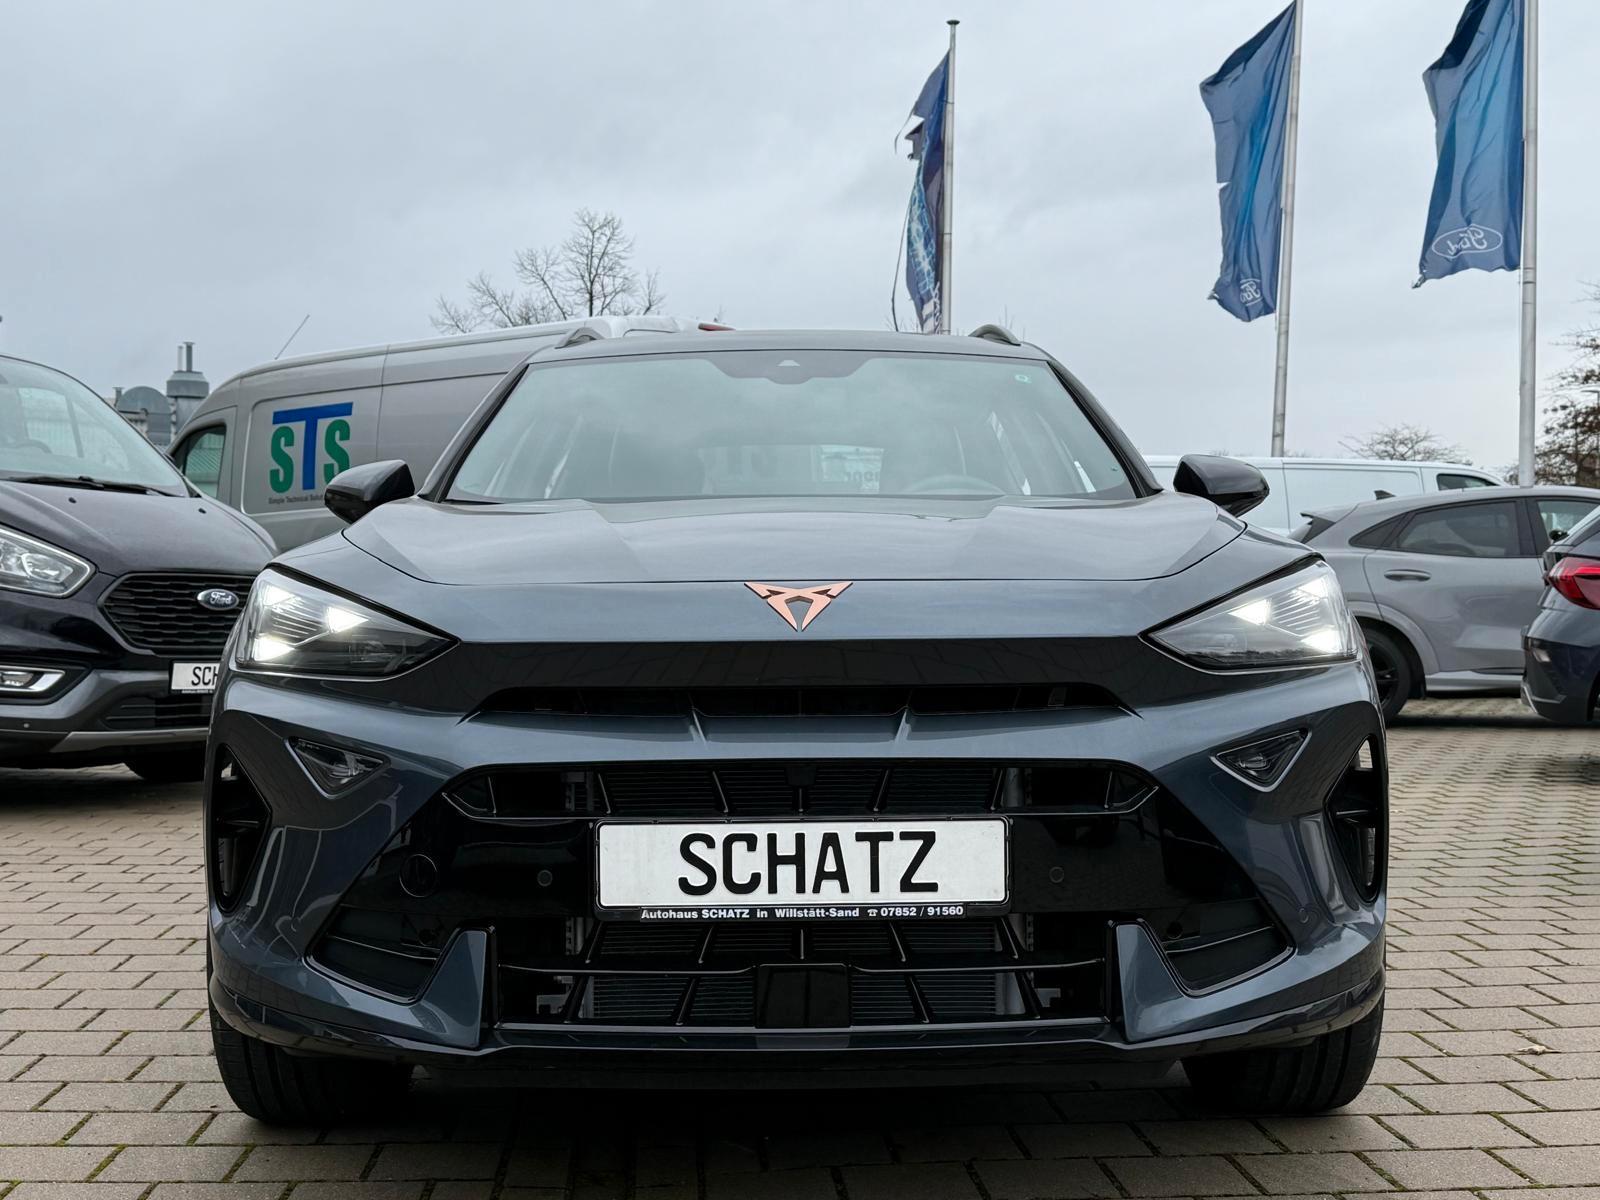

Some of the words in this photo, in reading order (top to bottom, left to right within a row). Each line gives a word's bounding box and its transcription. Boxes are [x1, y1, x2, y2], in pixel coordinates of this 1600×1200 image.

[269, 402, 354, 494] STS
[210, 591, 232, 605] Ford
[678, 831, 939, 896] SCHATZ
[641, 909, 699, 919] Autohaus
[701, 908, 750, 918] SCHATZ
[756, 908, 768, 918] in
[880, 907, 917, 917] 07852
[927, 905, 964, 916] 91560
